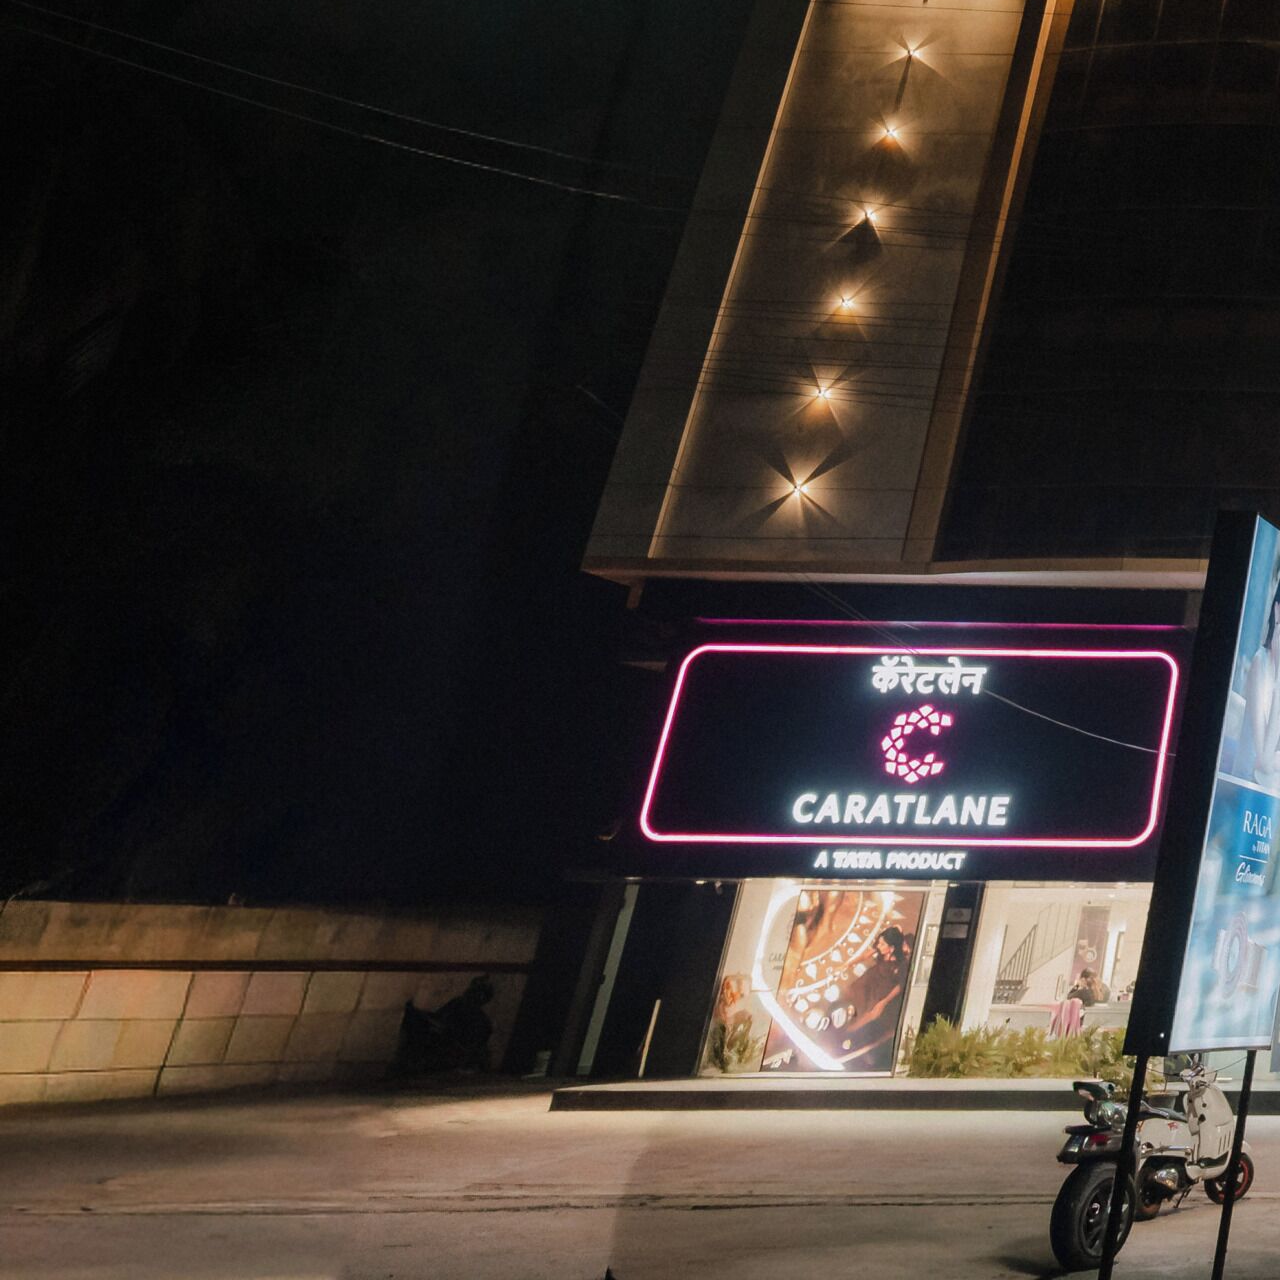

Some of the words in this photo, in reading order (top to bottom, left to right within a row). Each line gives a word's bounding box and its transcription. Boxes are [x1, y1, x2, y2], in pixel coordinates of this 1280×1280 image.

[792, 792, 1011, 826] CARATLANE
[1243, 810, 1272, 839] RAGA
[814, 851, 828, 869] A
[832, 851, 882, 870] TATA
[886, 851, 967, 870] PRODUCT
